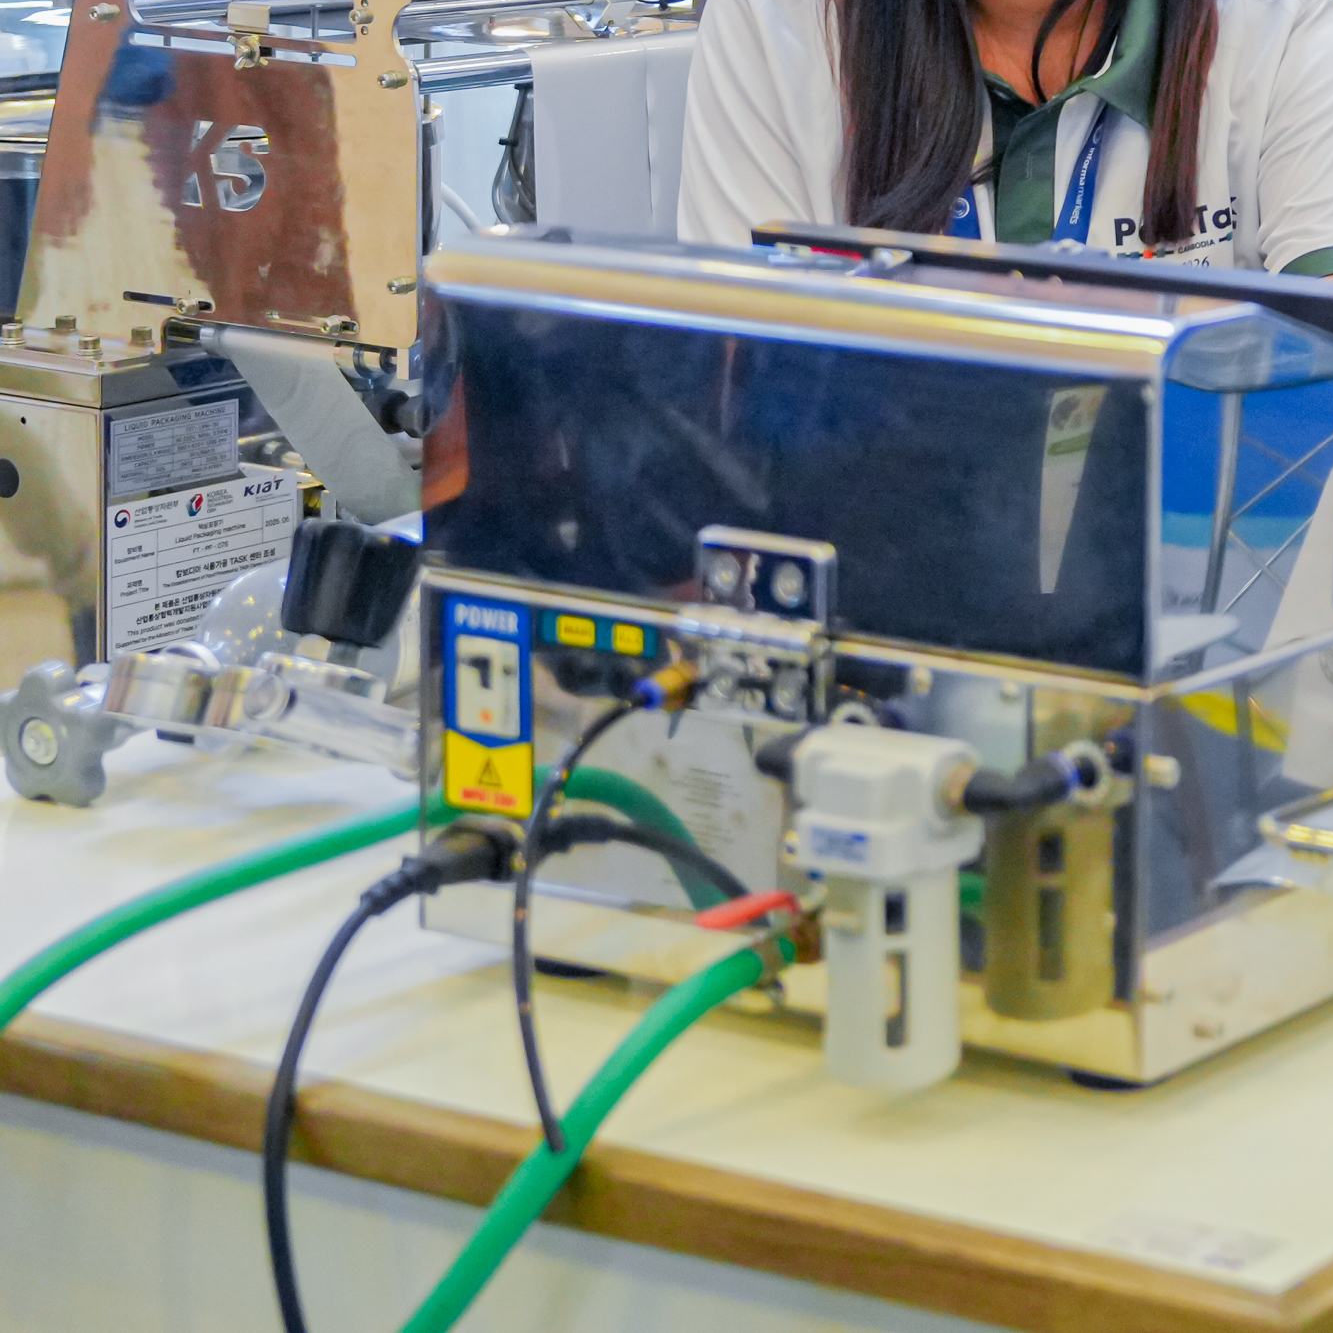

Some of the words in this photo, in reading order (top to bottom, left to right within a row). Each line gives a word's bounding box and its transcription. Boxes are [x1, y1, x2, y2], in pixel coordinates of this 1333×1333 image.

[151, 414, 191, 426] PACKAGING
[194, 407, 226, 418] MACHINE
[230, 554, 248, 565] TASK
[455, 603, 519, 634] POWER
[140, 623, 163, 634] product
